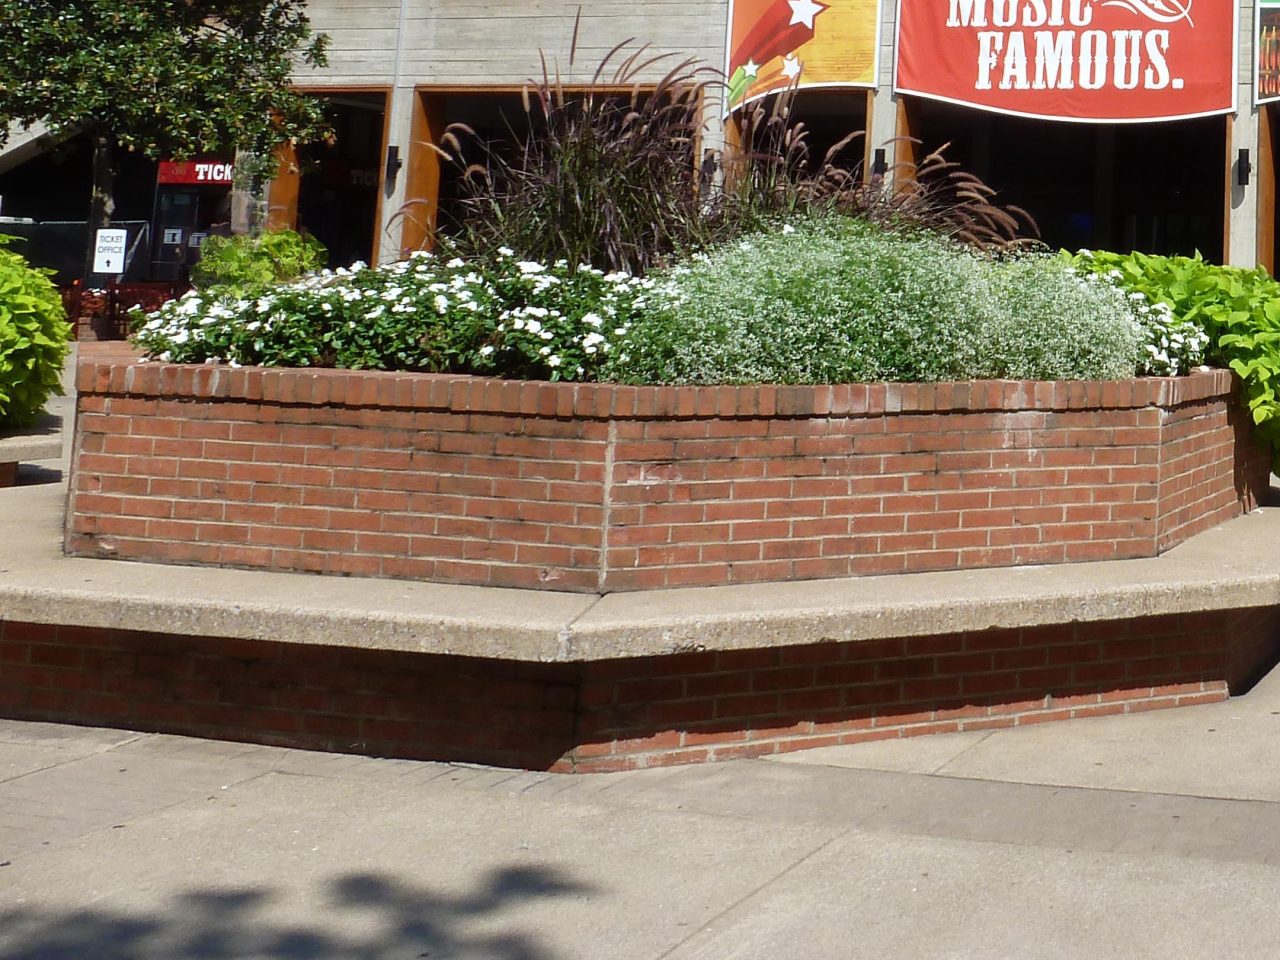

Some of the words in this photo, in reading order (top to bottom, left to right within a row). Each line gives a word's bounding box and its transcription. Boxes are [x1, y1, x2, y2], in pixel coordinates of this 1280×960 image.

[974, 29, 1184, 90] FAMOUS.
[99, 235, 123, 243] TICKET
[97, 246, 123, 254] OFFICE
